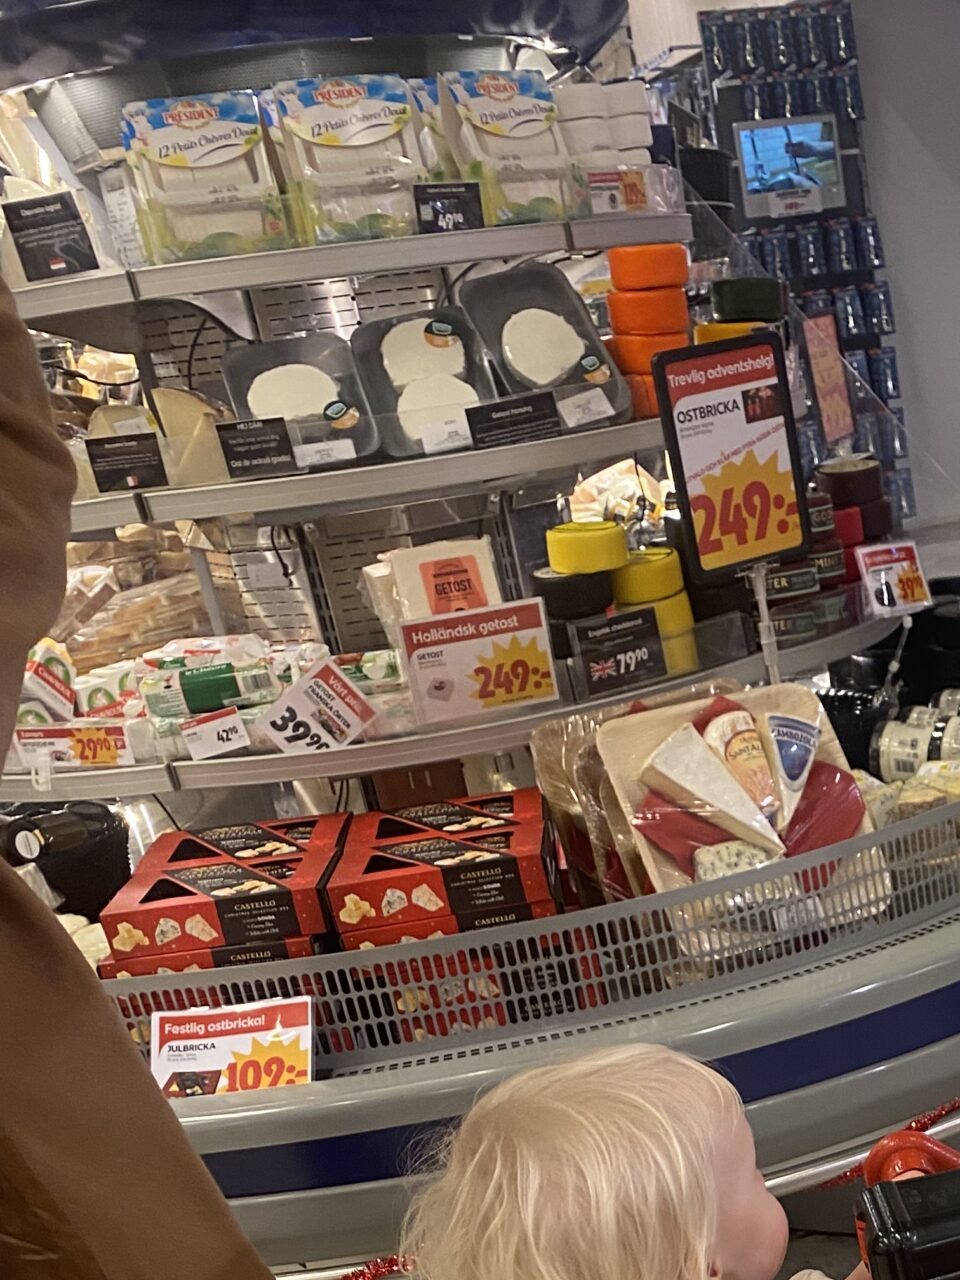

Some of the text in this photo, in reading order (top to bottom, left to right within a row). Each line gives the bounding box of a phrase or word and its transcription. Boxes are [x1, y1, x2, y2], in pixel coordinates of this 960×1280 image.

[311, 123, 322, 138] 12
[158, 145, 170, 159] 12
[667, 353, 774, 388] Trevlig adventshelg!
[676, 399, 741, 424] OSTBRICKA
[690, 480, 798, 557] 249:-
[434, 579, 473, 596] GETOST
[412, 615, 519, 645] Holländsk getost
[417, 650, 444, 661] GETOST
[328, 675, 347, 696] Vårt
[474, 659, 551, 699] 249:-
[460, 868, 502, 880] CASTELLO
[234, 899, 276, 911] CASTELLO
[475, 913, 516, 926] CASTELLO
[230, 950, 271, 962] CASTELLO
[164, 1015, 265, 1035] Festlig ostbricka!
[167, 1042, 217, 1053] JULBRICKA
[226, 1056, 308, 1092] 109:-
